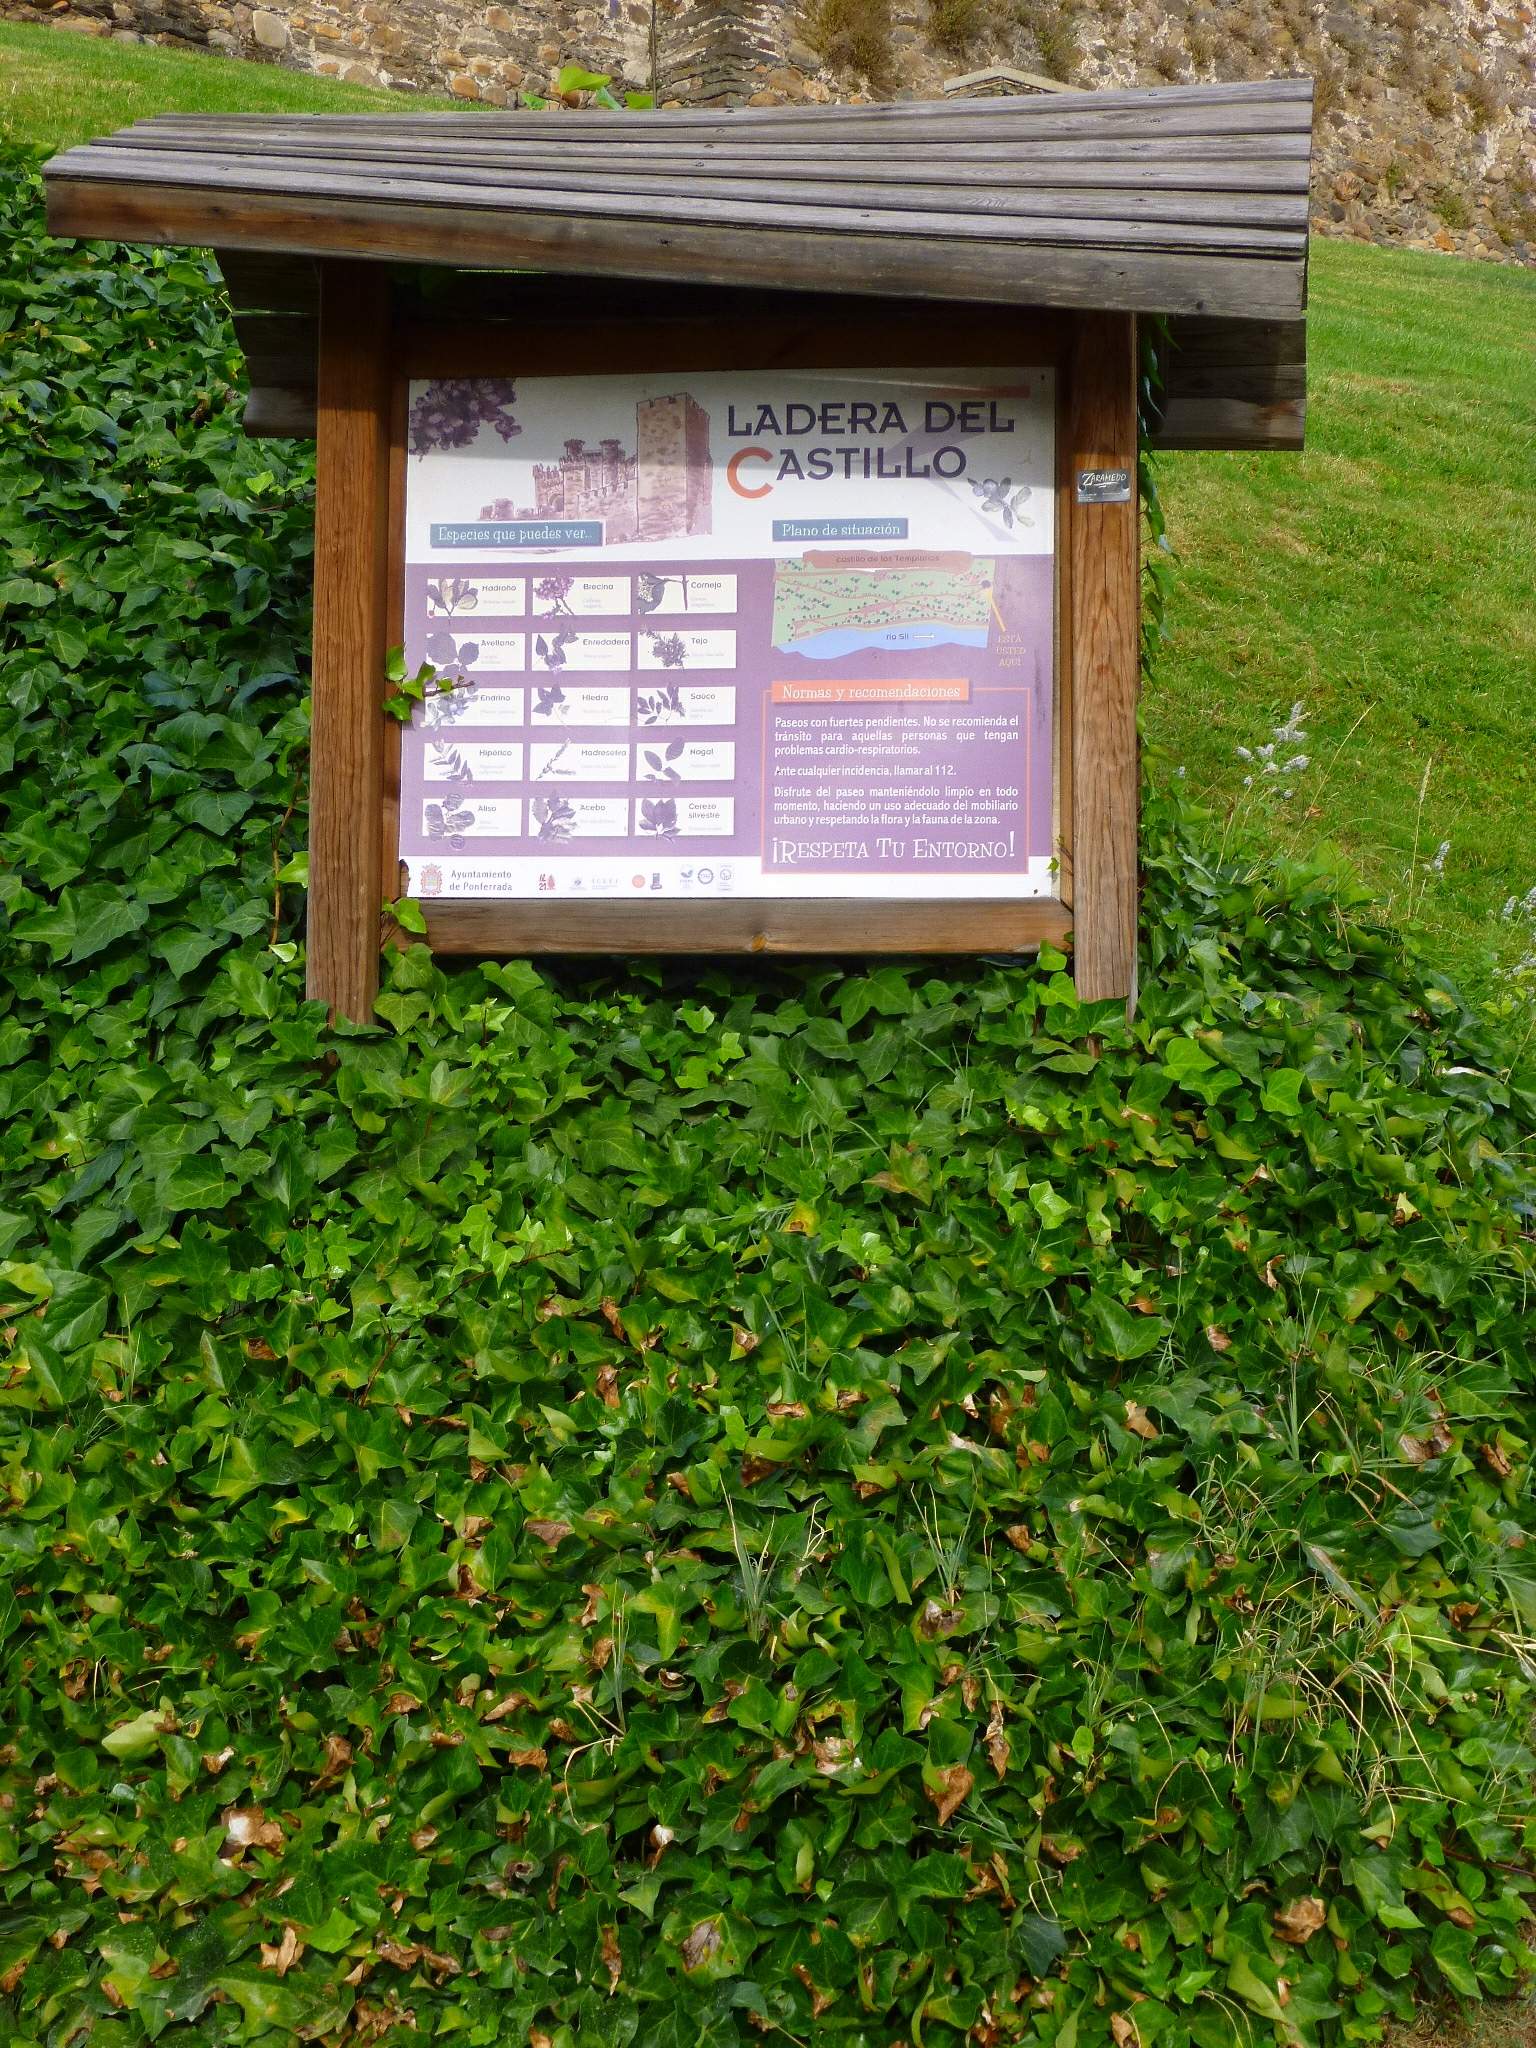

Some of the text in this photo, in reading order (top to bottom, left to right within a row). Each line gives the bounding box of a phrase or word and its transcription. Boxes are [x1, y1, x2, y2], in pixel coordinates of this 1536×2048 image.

[728, 401, 1015, 437] LADERA DEL
[726, 445, 967, 499] CASTILLO
[439, 527, 490, 545] Especies
[494, 531, 515, 544] que
[520, 526, 561, 543] puedes
[782, 522, 900, 537] Plano de situación
[690, 581, 722, 590] Cornejo
[481, 638, 516, 647] Avellano
[583, 638, 630, 646] Enredadera
[691, 637, 708, 646] Tejo
[582, 693, 609, 701] Hiedra
[783, 684, 960, 700] Normas y recomendaciones
[775, 717, 808, 728] Paseos
[811, 719, 827, 727] con
[830, 717, 863, 727] fuertes
[866, 716, 920, 728] pendientes.
[924, 716, 936, 725] No
[952, 715, 1007, 726] recomienda
[1010, 715, 1019, 725] el
[775, 731, 1018, 743] tránsito para aquellas personas que tengan
[690, 748, 714, 757] Nogal
[775, 745, 921, 757] problemas cardio-respiratorios.
[774, 765, 957, 778] Ante cualquier incidencia, llamar al 112.
[774, 787, 811, 797] Disfrute
[816, 787, 831, 797] del
[836, 789, 864, 799] paseo
[869, 786, 940, 797] manteniéndolo
[945, 786, 974, 798] limpio
[996, 786, 1018, 796] todo
[580, 804, 606, 812] Acebo
[774, 799, 1018, 812] momento, haciendo un uso adecuado del mobiliario
[774, 814, 1001, 827] urbano y respetando la flora y la fauna de la zona.
[772, 831, 1015, 864] ¡RESPETA TU ENTORNO!
[451, 870, 512, 881] Ayuntamiento
[449, 881, 513, 891] de Ponferrada
